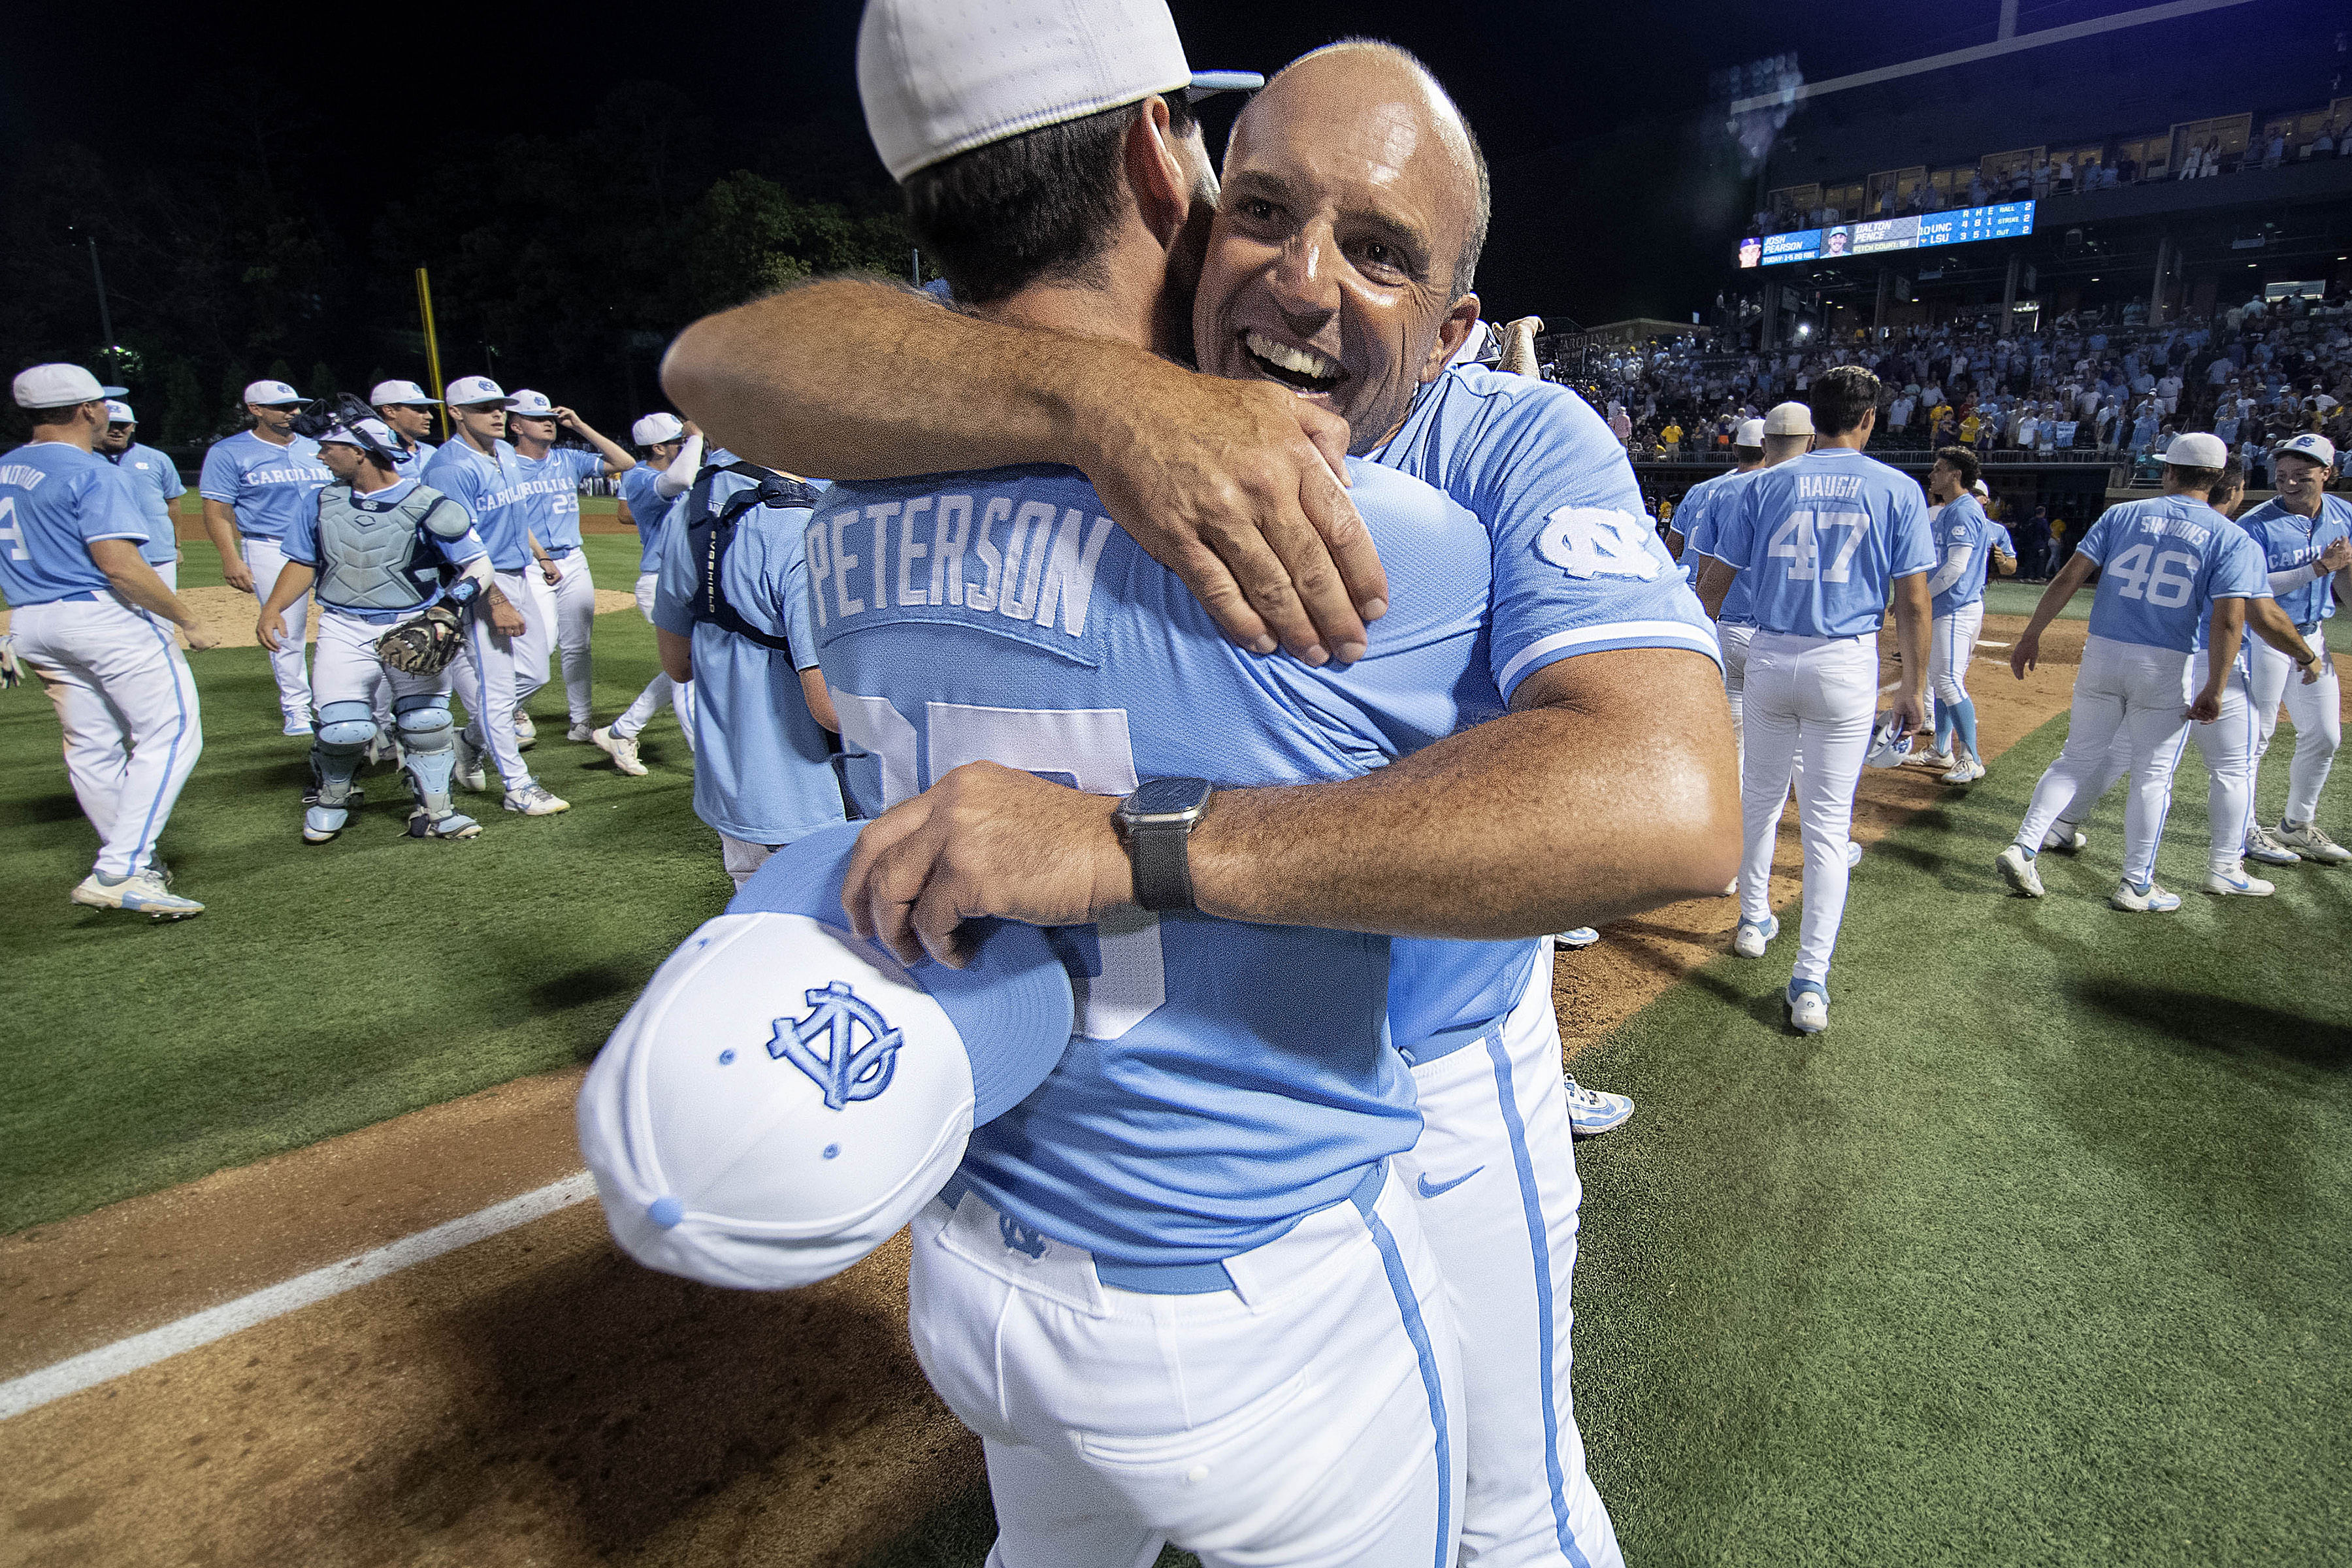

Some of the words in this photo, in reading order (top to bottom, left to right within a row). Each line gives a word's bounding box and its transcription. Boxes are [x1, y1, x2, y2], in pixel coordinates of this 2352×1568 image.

[2025, 202, 2031, 210] 2
[1856, 221, 1892, 234] DALTON
[1931, 223, 1952, 233] UNC
[1998, 216, 2019, 225] STRIKE
[1765, 235, 1786, 246] JOSH
[1855, 231, 1885, 242] PENCE
[1930, 233, 1949, 244] LSU
[1765, 241, 1803, 253] PEARSON
[1799, 476, 1861, 498] HAUGH
[552, 492, 580, 514] 28
[2140, 515, 2211, 546] SIMMONS
[1767, 510, 1870, 583] 47
[806, 495, 1115, 638] PETERSON
[2107, 543, 2201, 609] 46
